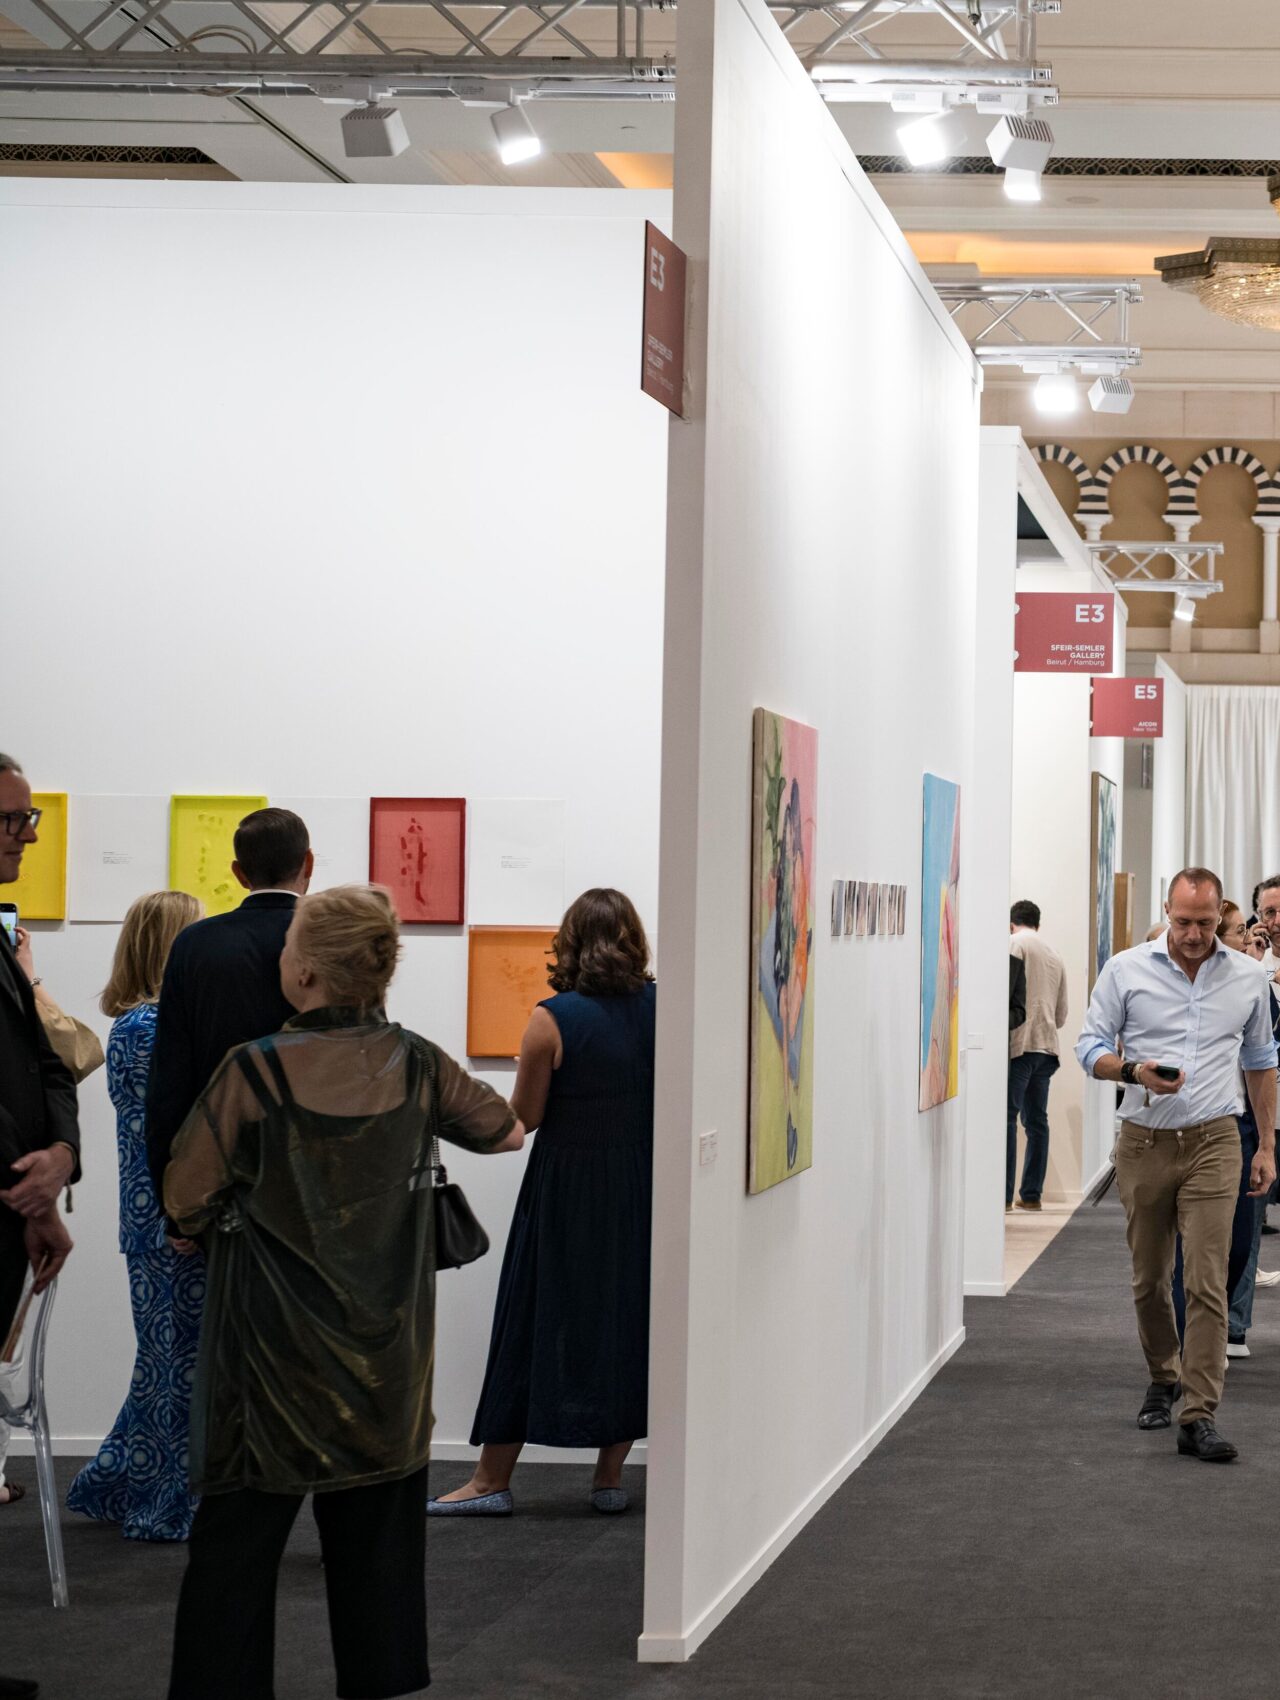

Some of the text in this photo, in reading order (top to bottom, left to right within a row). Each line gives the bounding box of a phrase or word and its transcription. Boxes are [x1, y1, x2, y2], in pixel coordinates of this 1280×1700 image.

[650, 246, 666, 292] E3
[1075, 604, 1105, 623] E3
[1050, 644, 1105, 652] SFEIR-SEMLER
[1074, 659, 1105, 667] Hamburg
[1134, 685, 1157, 699] E5
